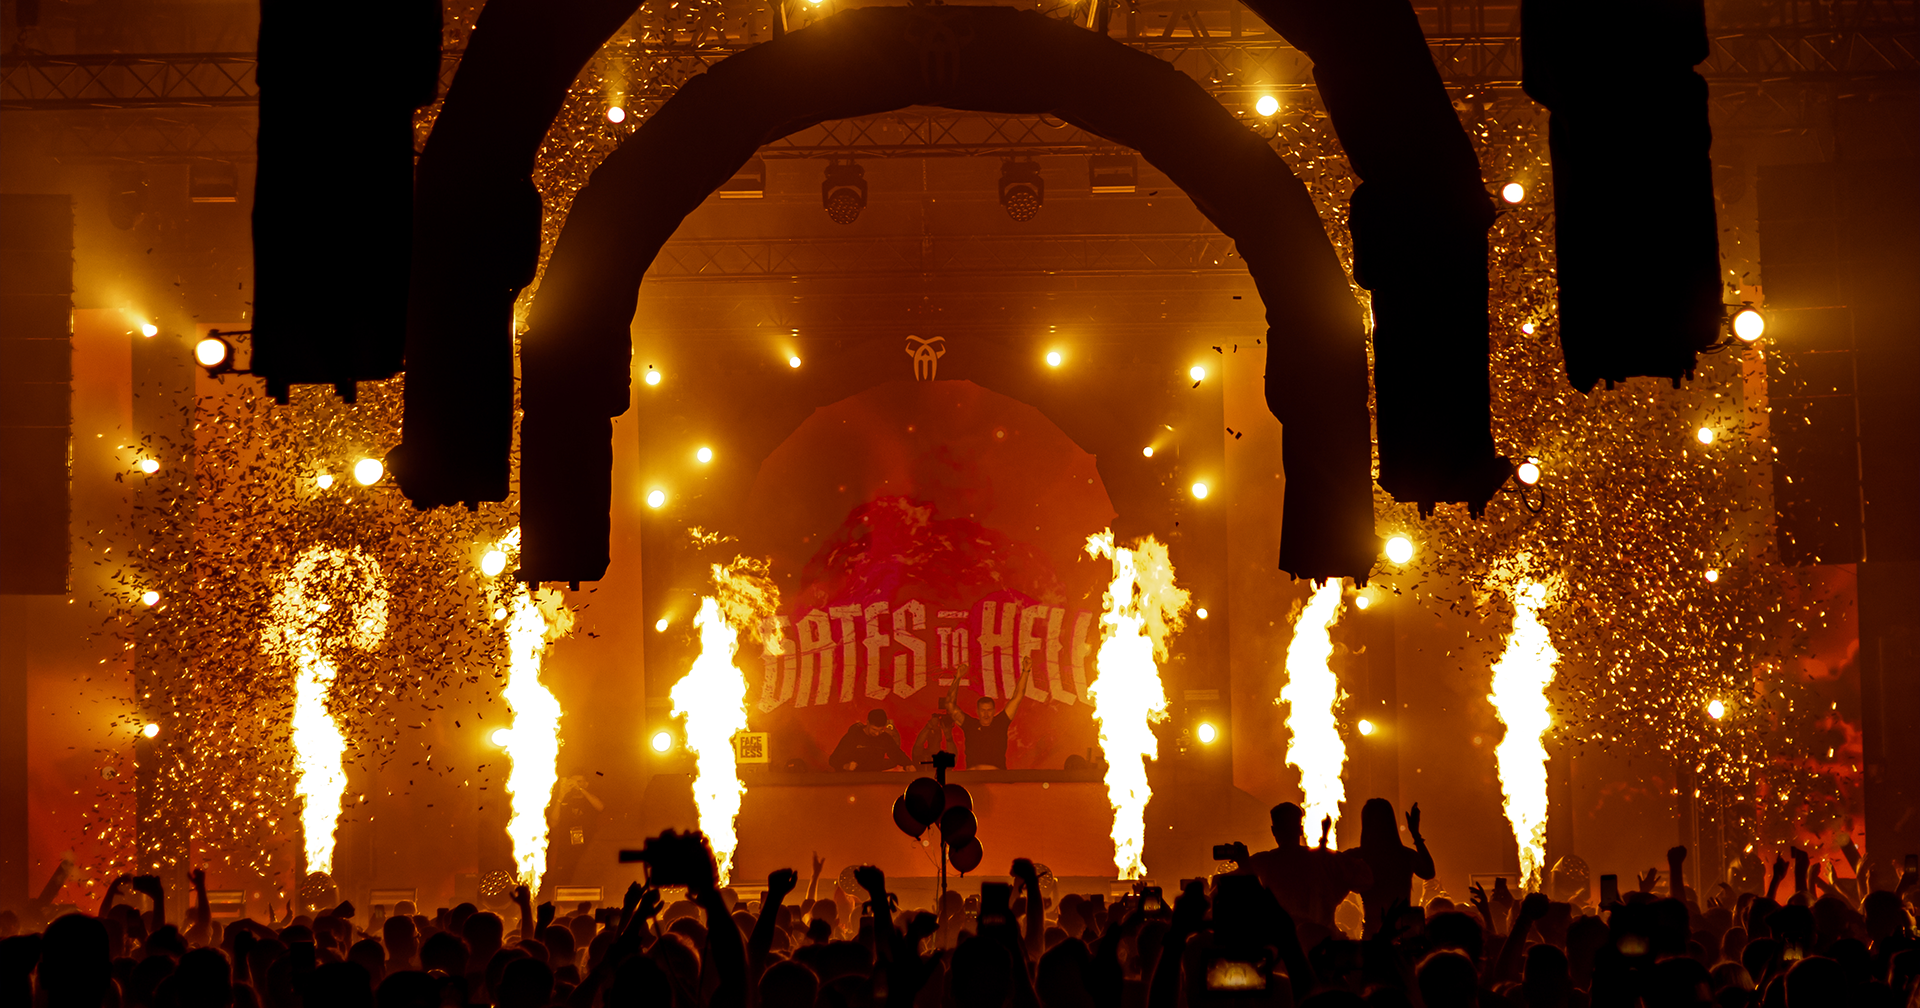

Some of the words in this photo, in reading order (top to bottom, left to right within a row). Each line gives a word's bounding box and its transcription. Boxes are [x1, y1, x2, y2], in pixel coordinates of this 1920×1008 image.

[758, 599, 927, 713] GATES
[937, 627, 969, 669] TO
[976, 601, 1097, 707] HELL
[740, 736, 762, 746] FACE
[740, 748, 763, 758] LESS
